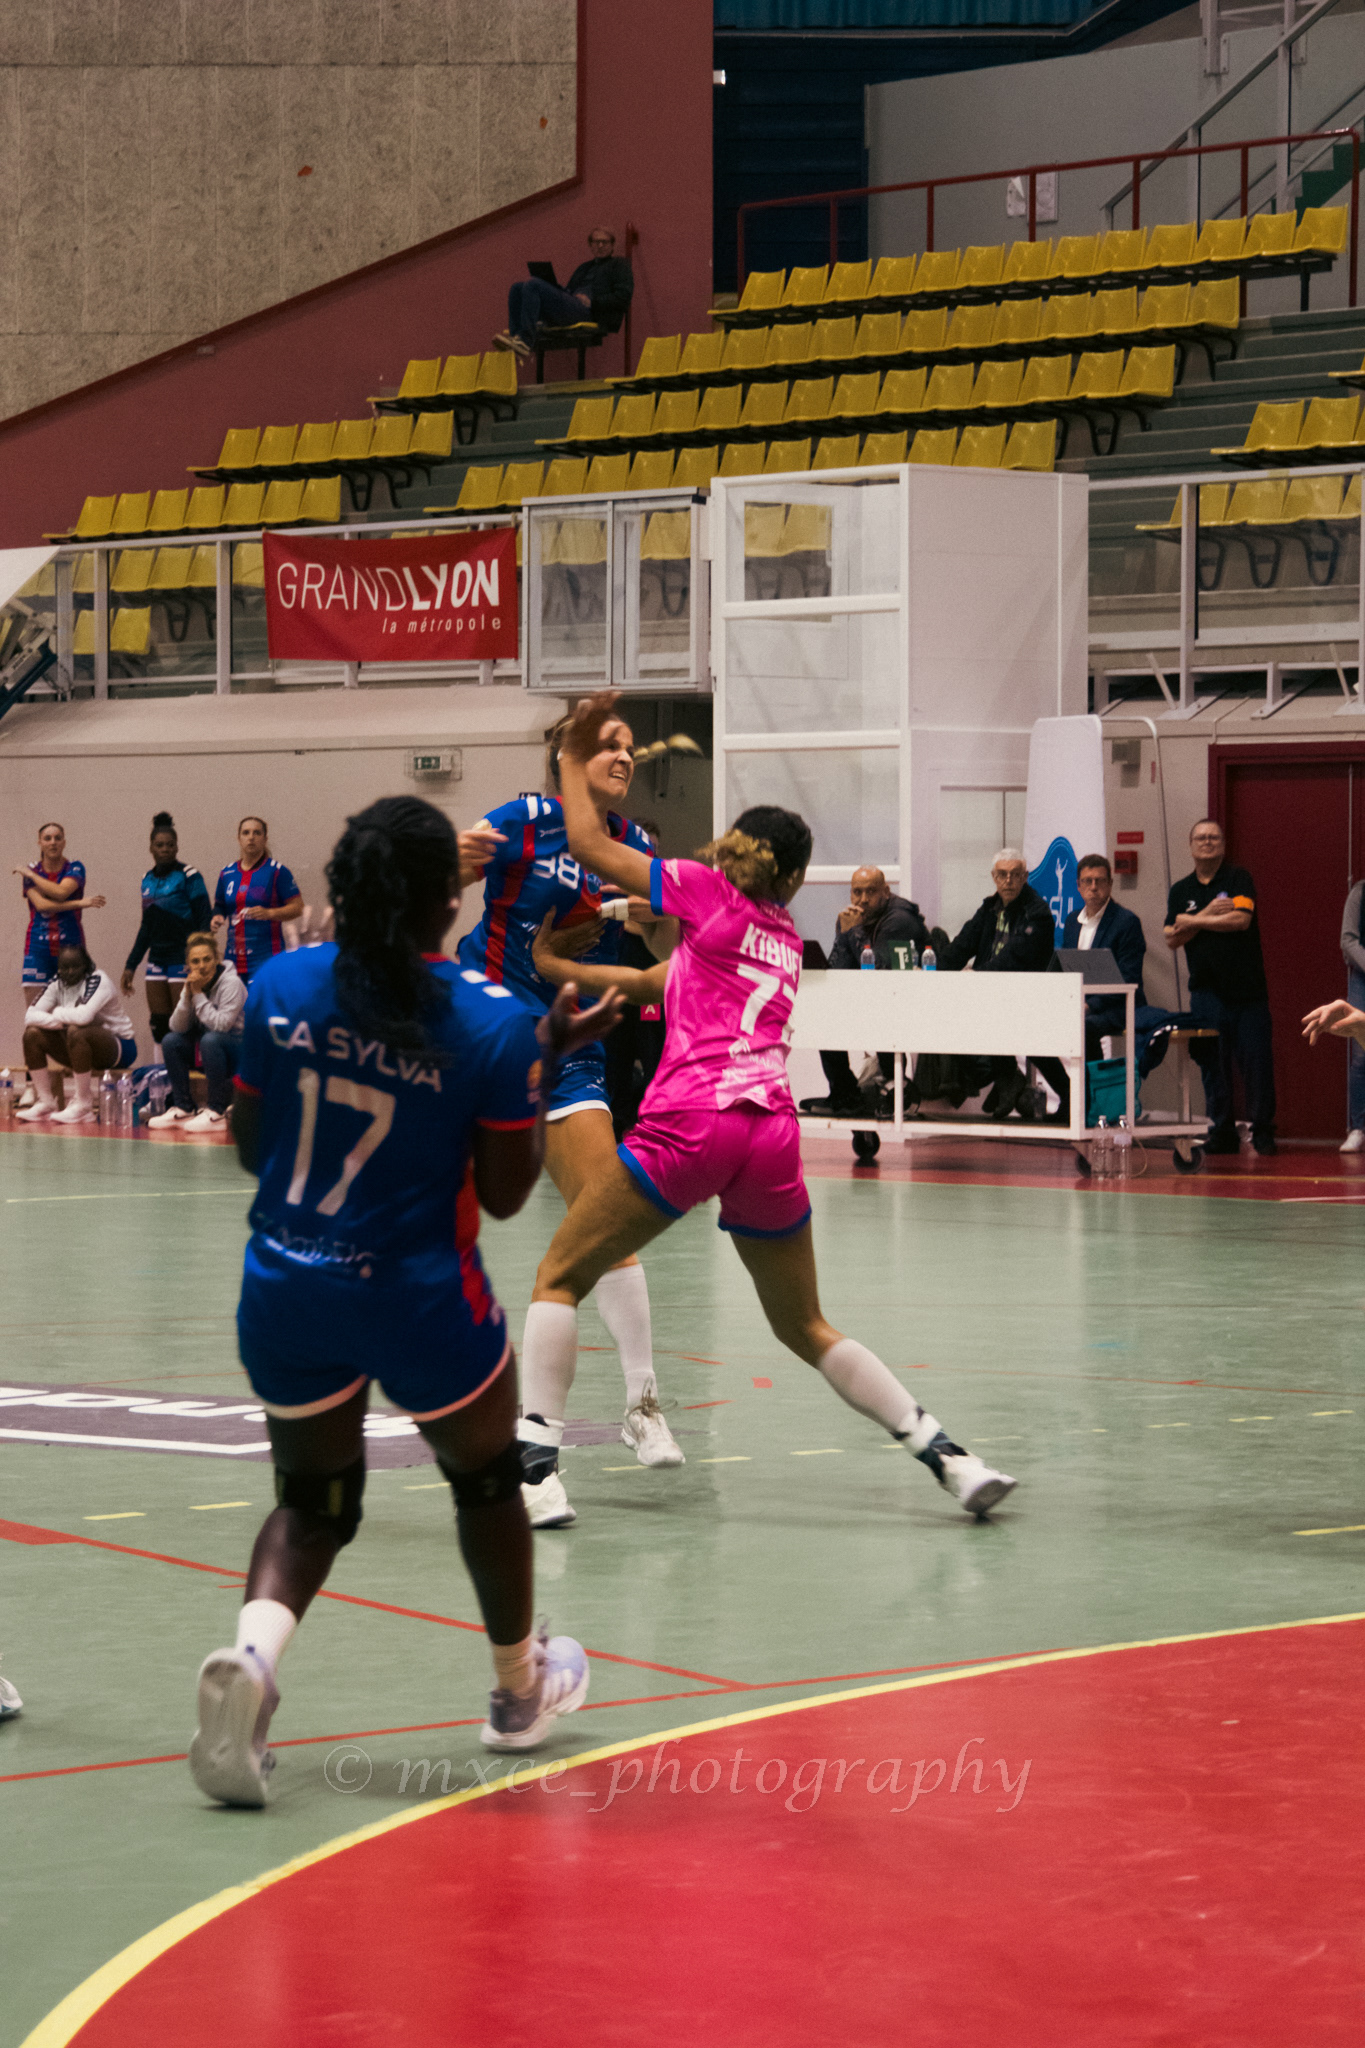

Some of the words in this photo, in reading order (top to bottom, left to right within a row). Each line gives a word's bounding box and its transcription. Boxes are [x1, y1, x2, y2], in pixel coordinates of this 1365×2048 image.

[277, 558, 500, 611] GRANDLYON
[382, 617, 397, 634] la
[407, 614, 501, 634] métropole
[226, 880, 234, 897] 4
[644, 1004, 656, 1015] A
[326, 1026, 443, 1093] SYLVA
[286, 1067, 396, 1217] 17
